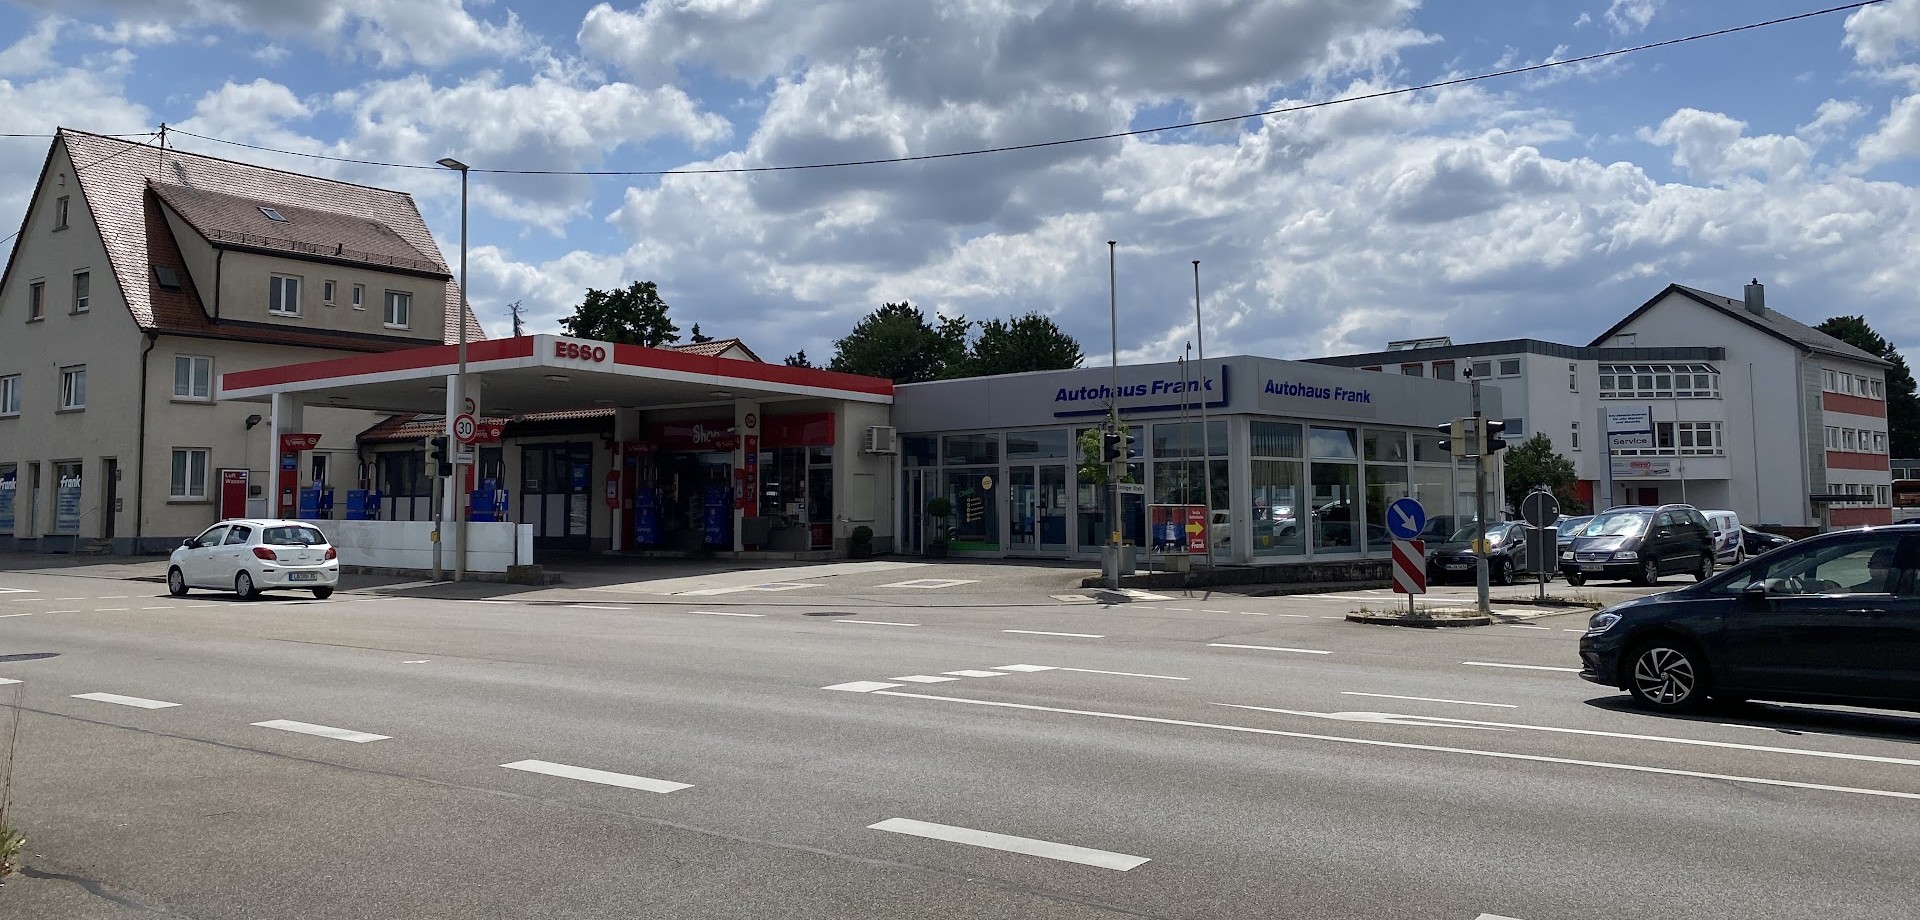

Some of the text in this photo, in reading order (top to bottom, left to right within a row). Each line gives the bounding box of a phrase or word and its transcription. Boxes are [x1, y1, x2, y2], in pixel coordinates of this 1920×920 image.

[554, 341, 606, 363] ESSO
[1054, 376, 1214, 402] Autohaus Frank
[1264, 379, 1371, 404] Autohaus Frank
[458, 422, 472, 435] 30
[1613, 437, 1648, 445] Service
